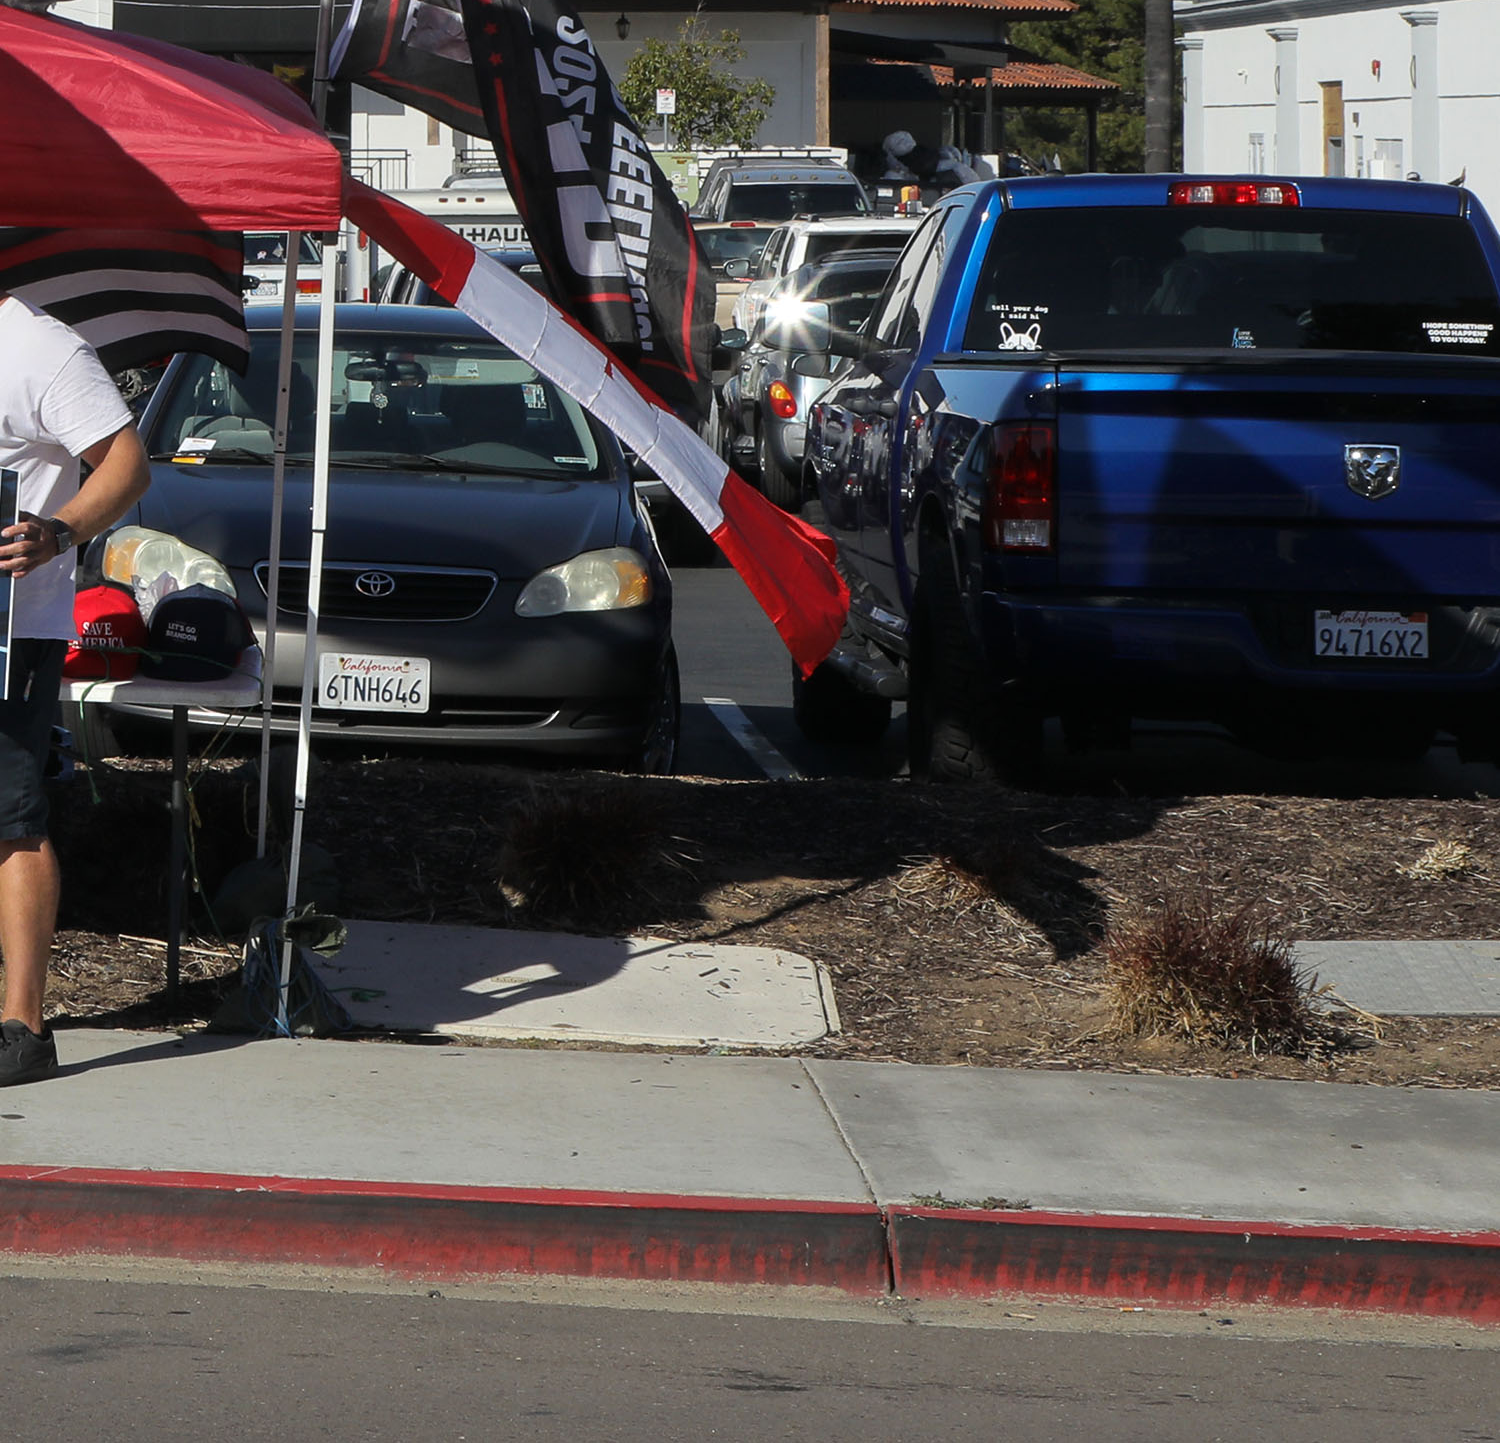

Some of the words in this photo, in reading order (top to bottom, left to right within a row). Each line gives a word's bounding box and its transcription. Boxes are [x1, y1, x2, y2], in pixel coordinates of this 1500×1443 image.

[1448, 323, 1494, 331] SOMETHING
[82, 621, 113, 636] SAVE
[165, 629, 198, 642] BRANDON
[168, 622, 185, 632] LET'S
[185, 625, 197, 634] GO
[1319, 628, 1423, 656] 94716X2
[341, 657, 409, 675] California
[326, 674, 422, 704] 6TNH646
